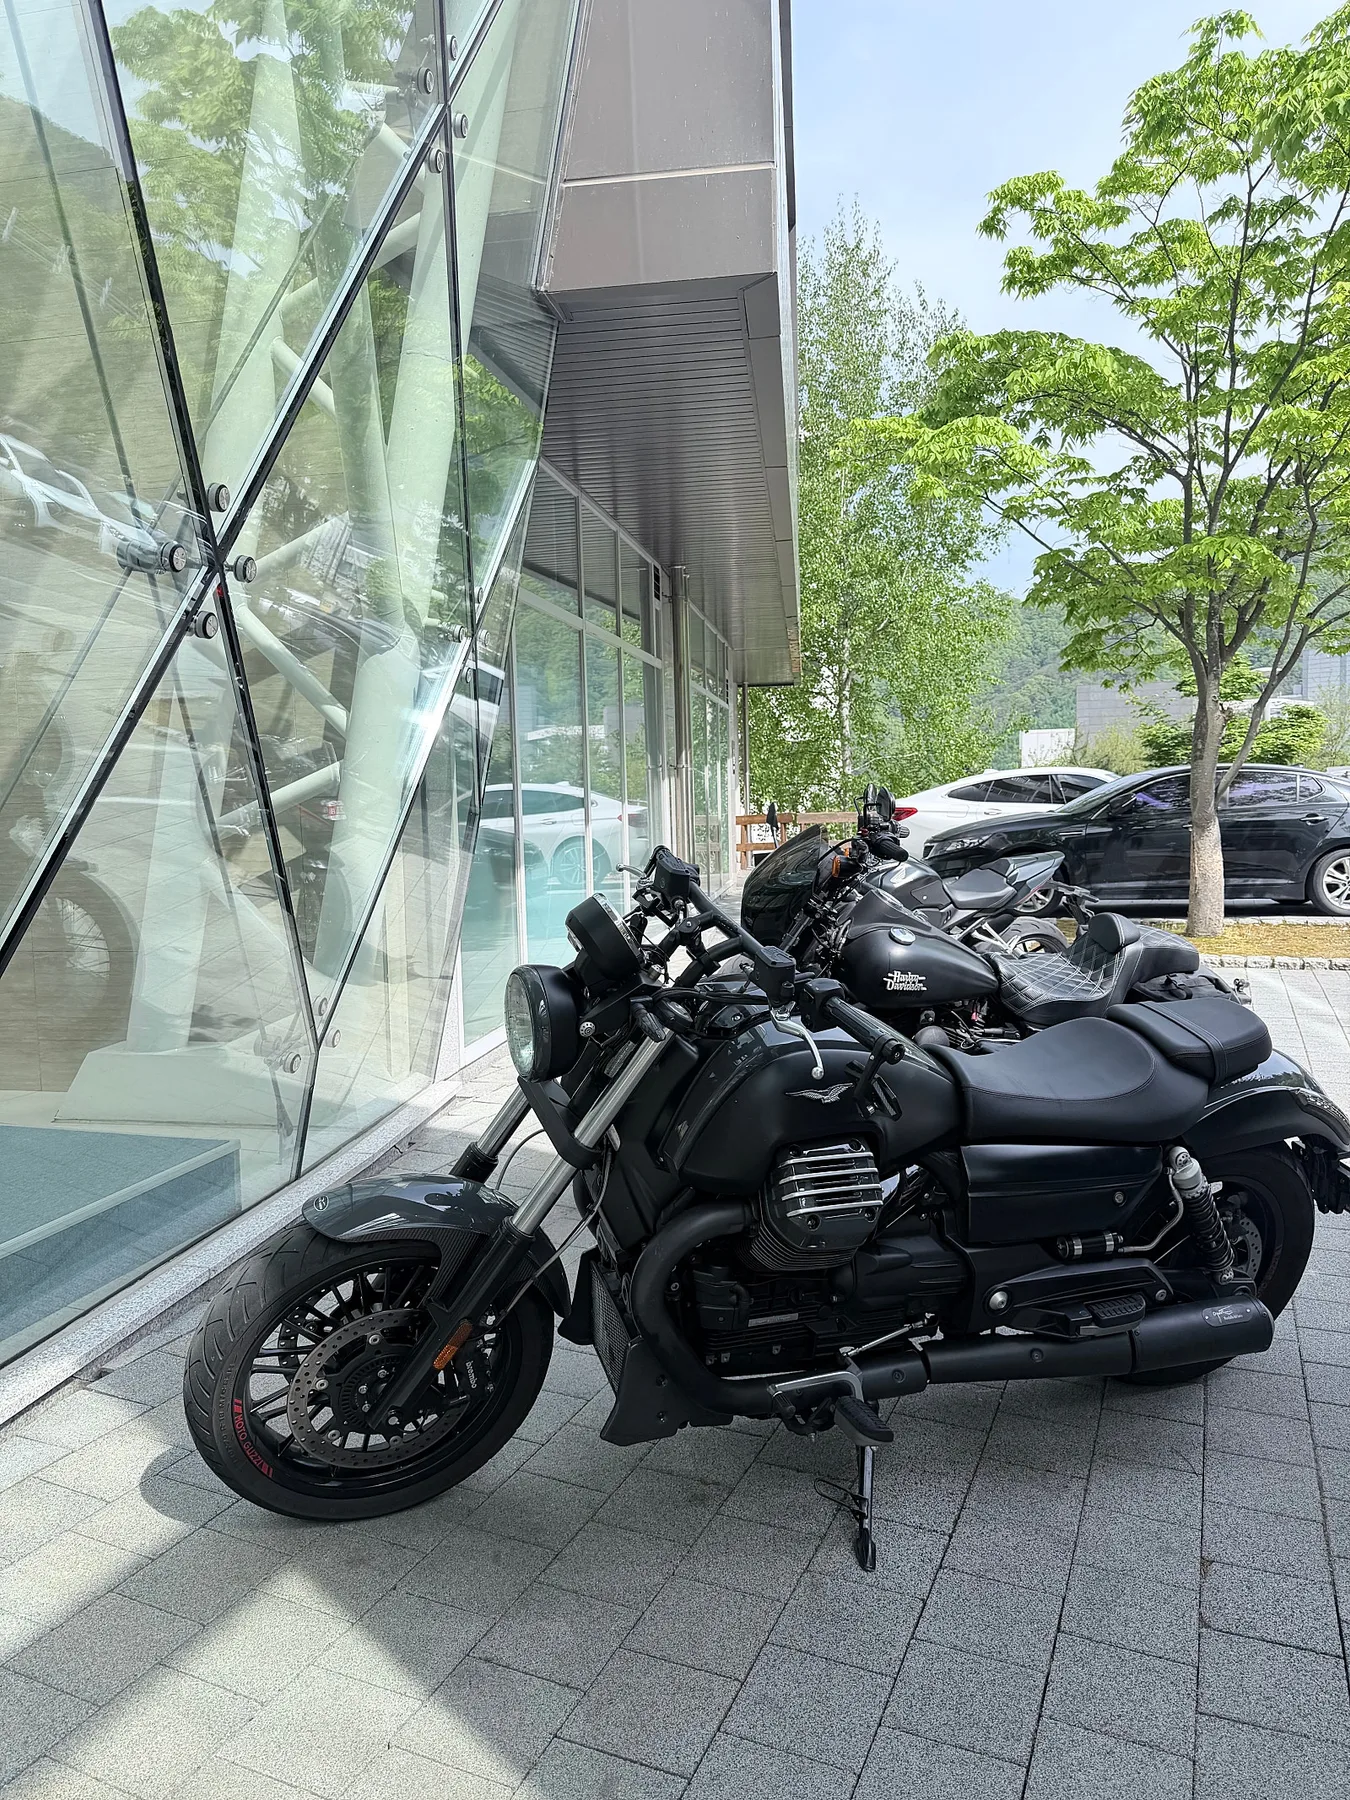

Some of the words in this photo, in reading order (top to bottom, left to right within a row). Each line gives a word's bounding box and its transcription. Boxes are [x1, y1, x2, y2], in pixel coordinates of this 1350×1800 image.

[465, 1360, 477, 1389] brembo
[234, 1414, 247, 1441] MOTO
[243, 1441, 264, 1468] GUZZI
